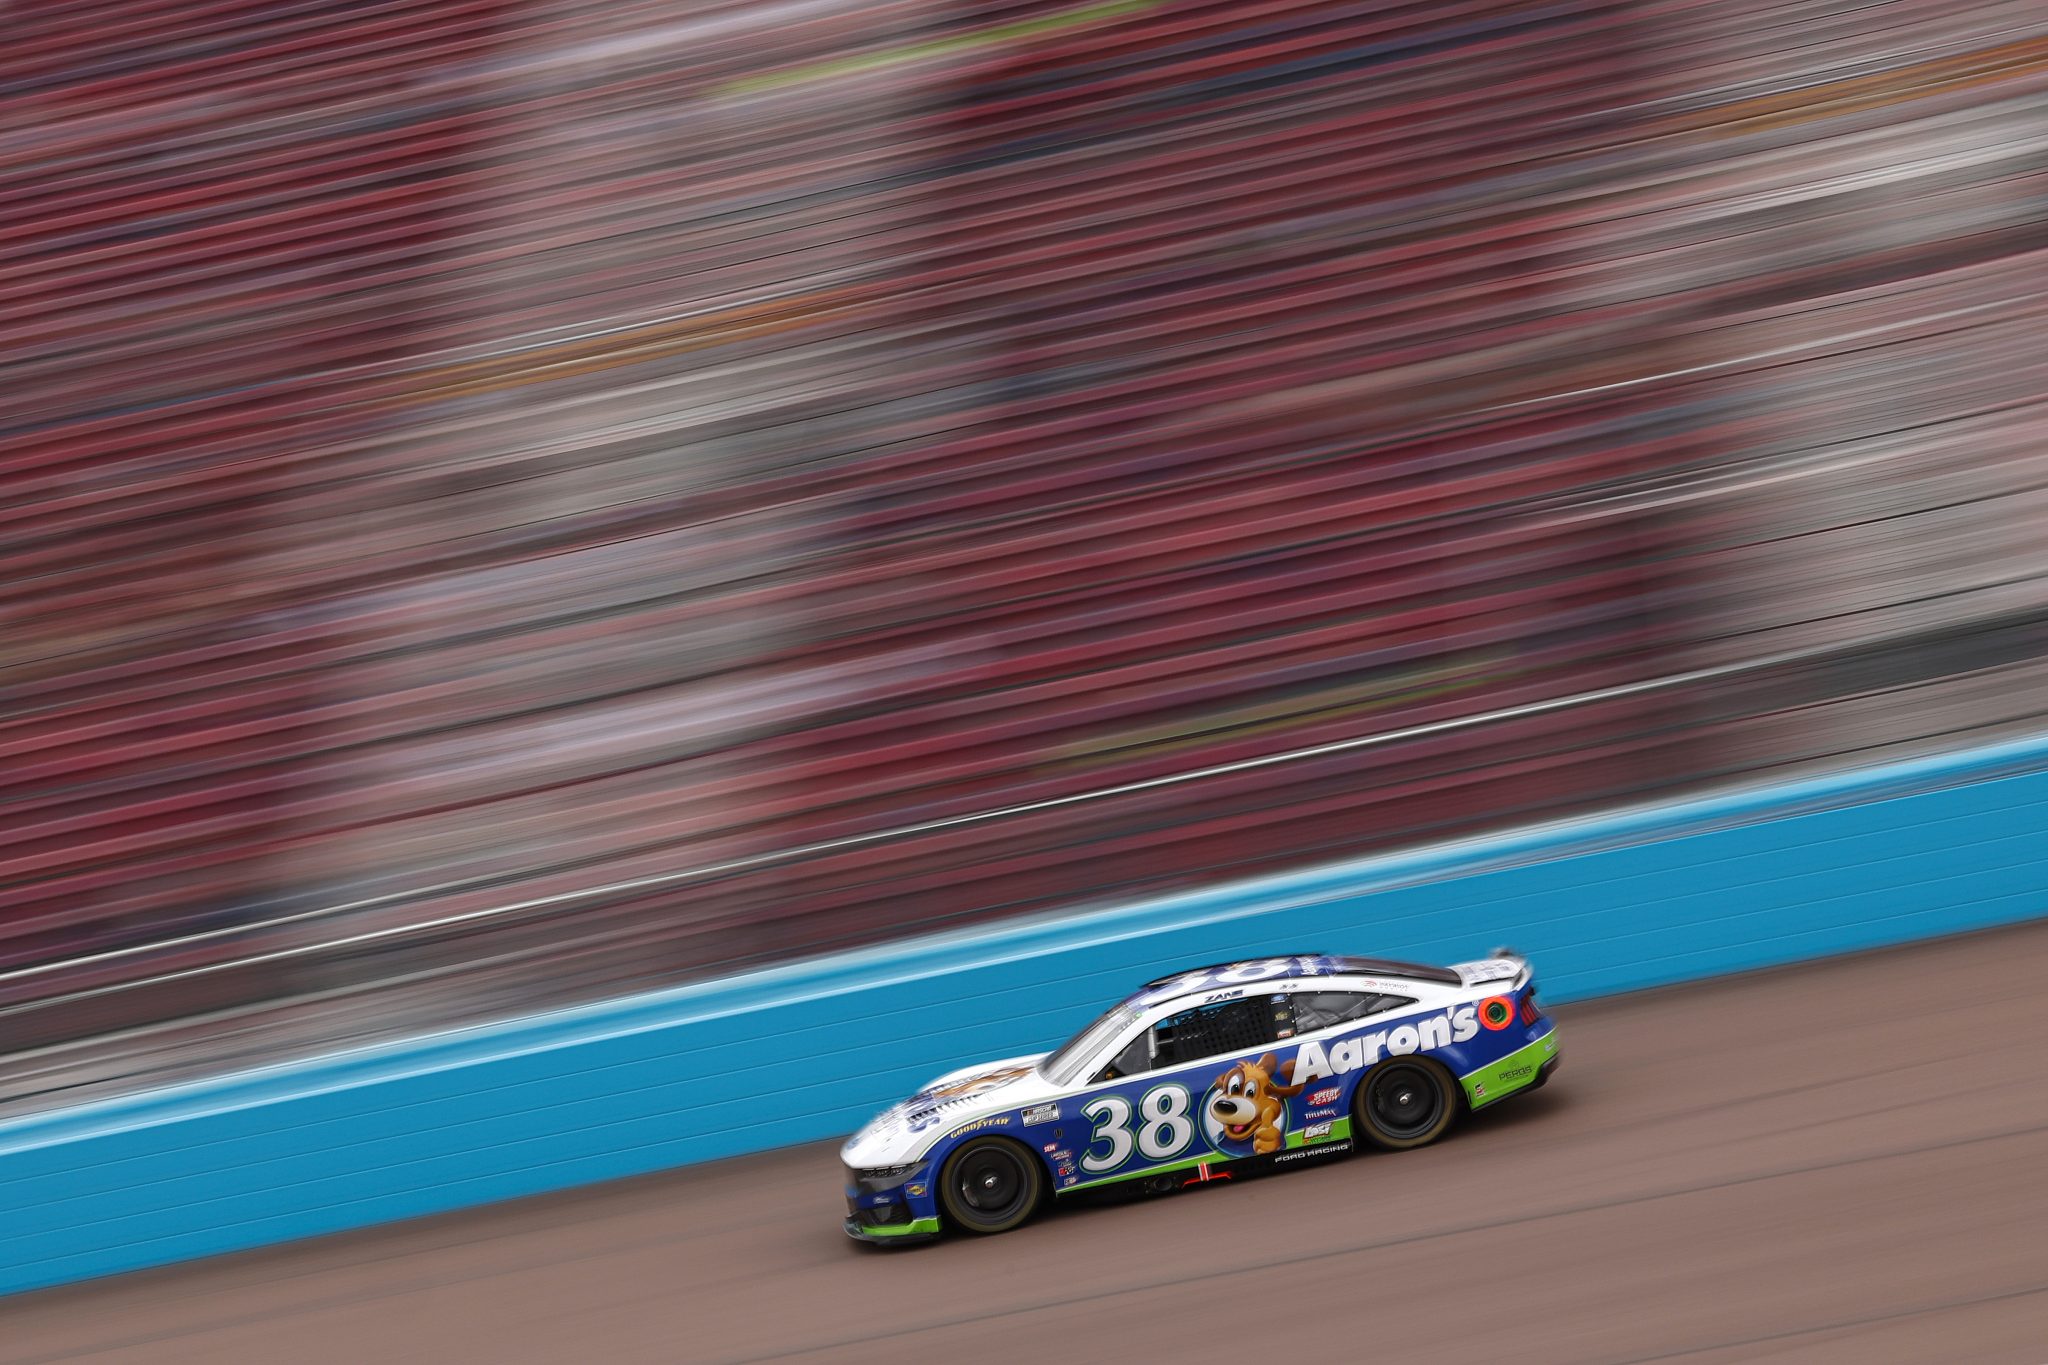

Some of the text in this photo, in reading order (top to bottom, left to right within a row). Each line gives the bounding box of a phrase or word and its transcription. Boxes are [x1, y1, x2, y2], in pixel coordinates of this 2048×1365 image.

[1204, 990, 1244, 1003] ZANE
[1291, 1006, 1479, 1086] Aaron's
[1313, 1087, 1340, 1101] SPEEDY
[1315, 1096, 1338, 1105] CASH
[950, 1116, 1010, 1139] GOODYEAR
[1080, 1084, 1193, 1173] 38
[1274, 1144, 1349, 1163] FORD RACING
